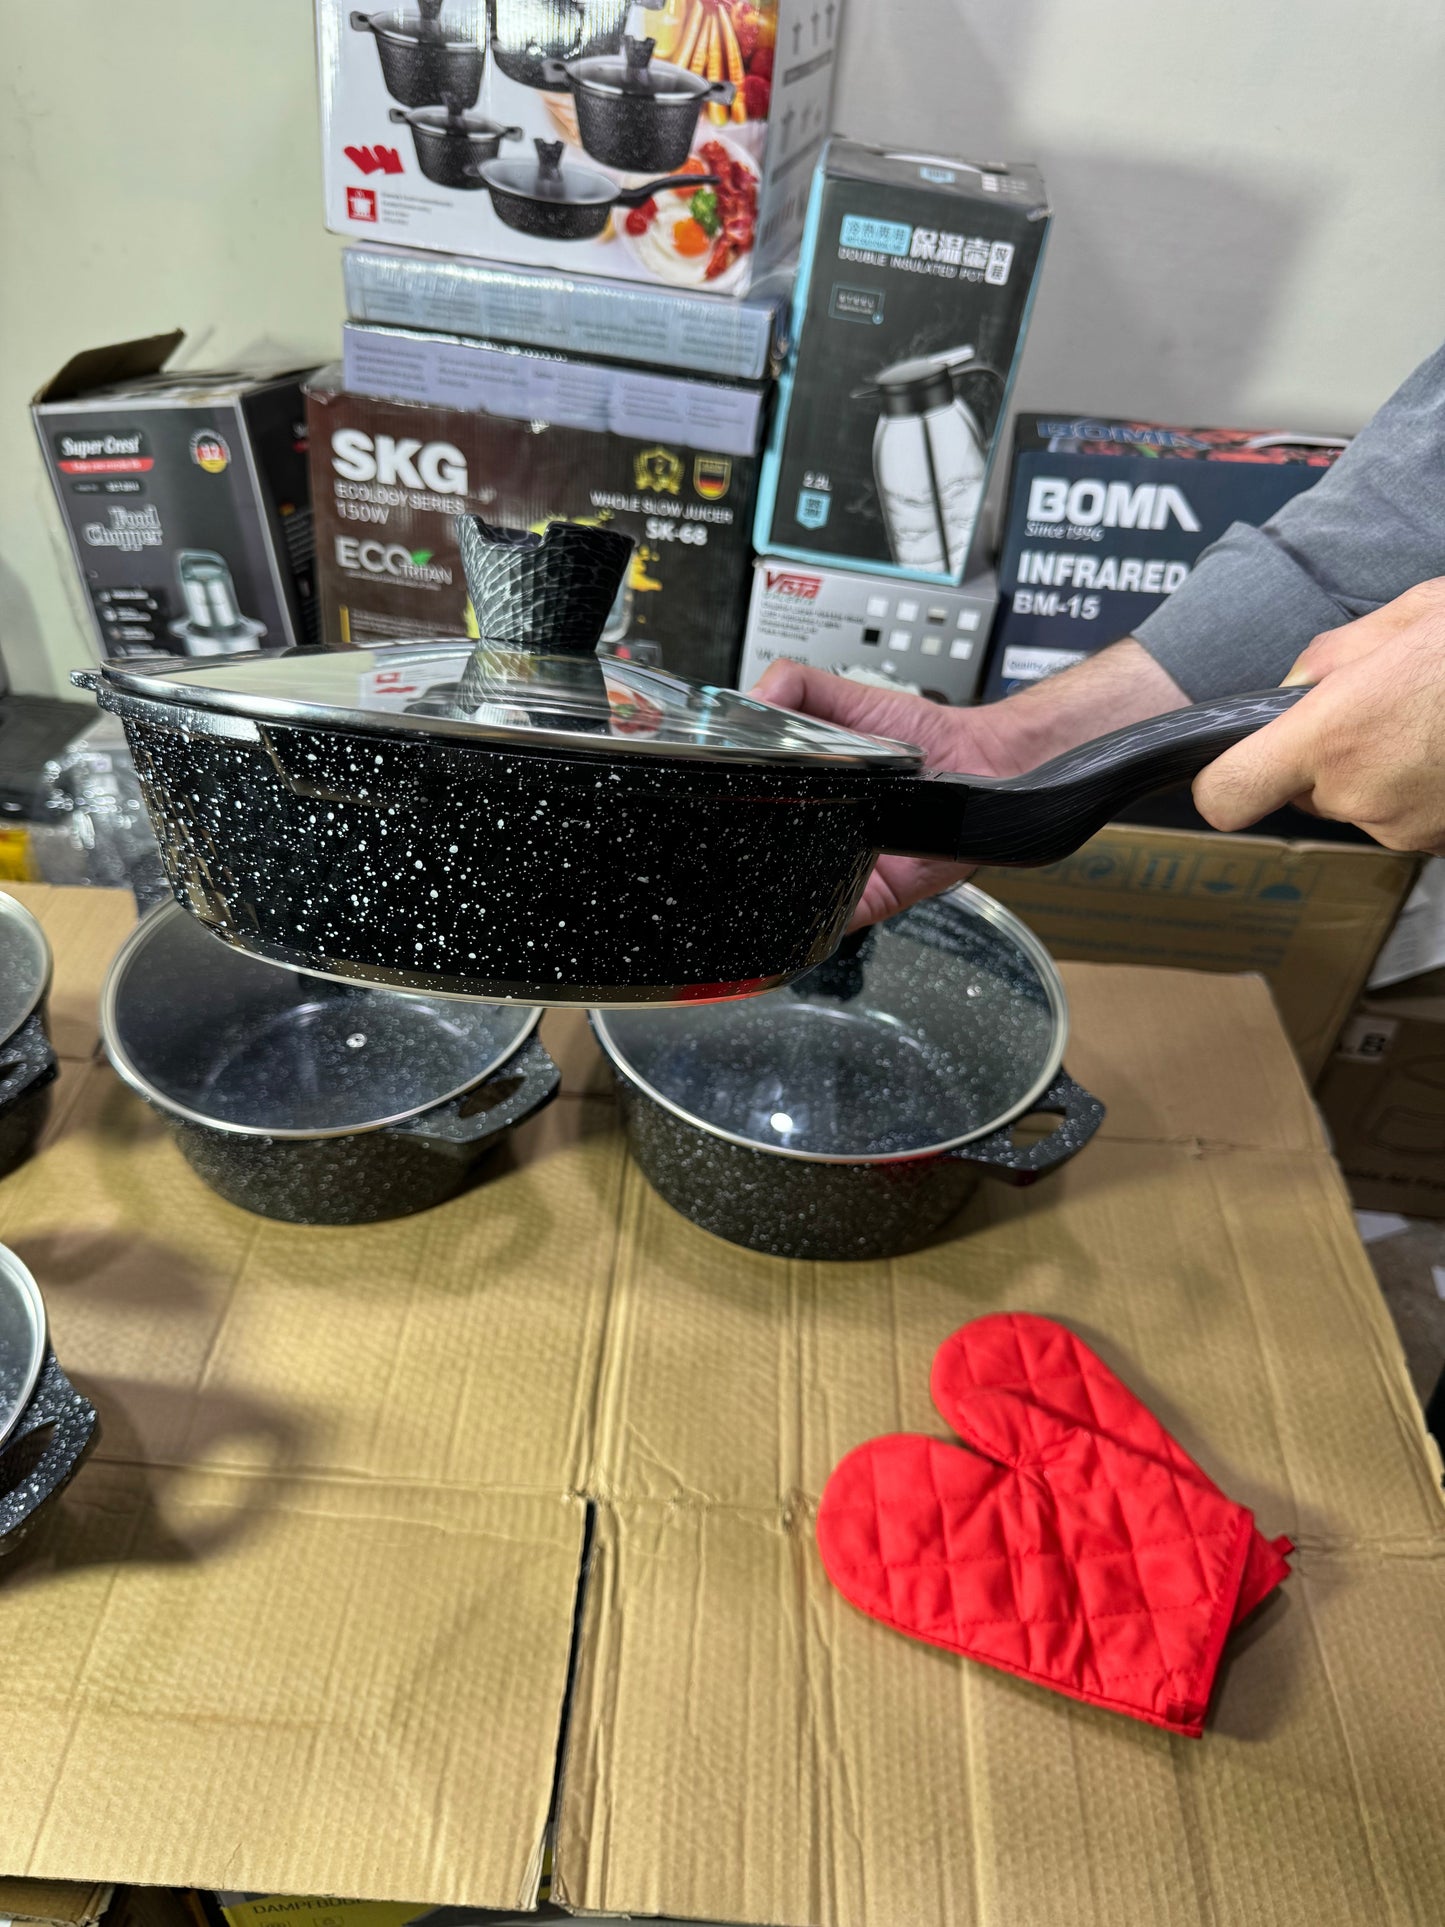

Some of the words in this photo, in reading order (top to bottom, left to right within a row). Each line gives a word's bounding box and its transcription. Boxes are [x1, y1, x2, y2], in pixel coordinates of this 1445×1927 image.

[838, 246, 888, 267] DOUBLE
[889, 256, 959, 280] INSULATED
[959, 267, 985, 283] POT
[331, 428, 468, 496] SKG
[334, 478, 408, 507] ECOLOGY
[408, 491, 466, 515] SERIES
[590, 490, 641, 513] WHOLE
[641, 496, 683, 518] SLOW
[682, 503, 734, 525] JUICER
[1026, 475, 1202, 533] BOMA
[1025, 521, 1066, 539] Since
[334, 535, 414, 577] ECO
[1017, 549, 1191, 595] INFRARED
[1012, 588, 1101, 620] BM-15
